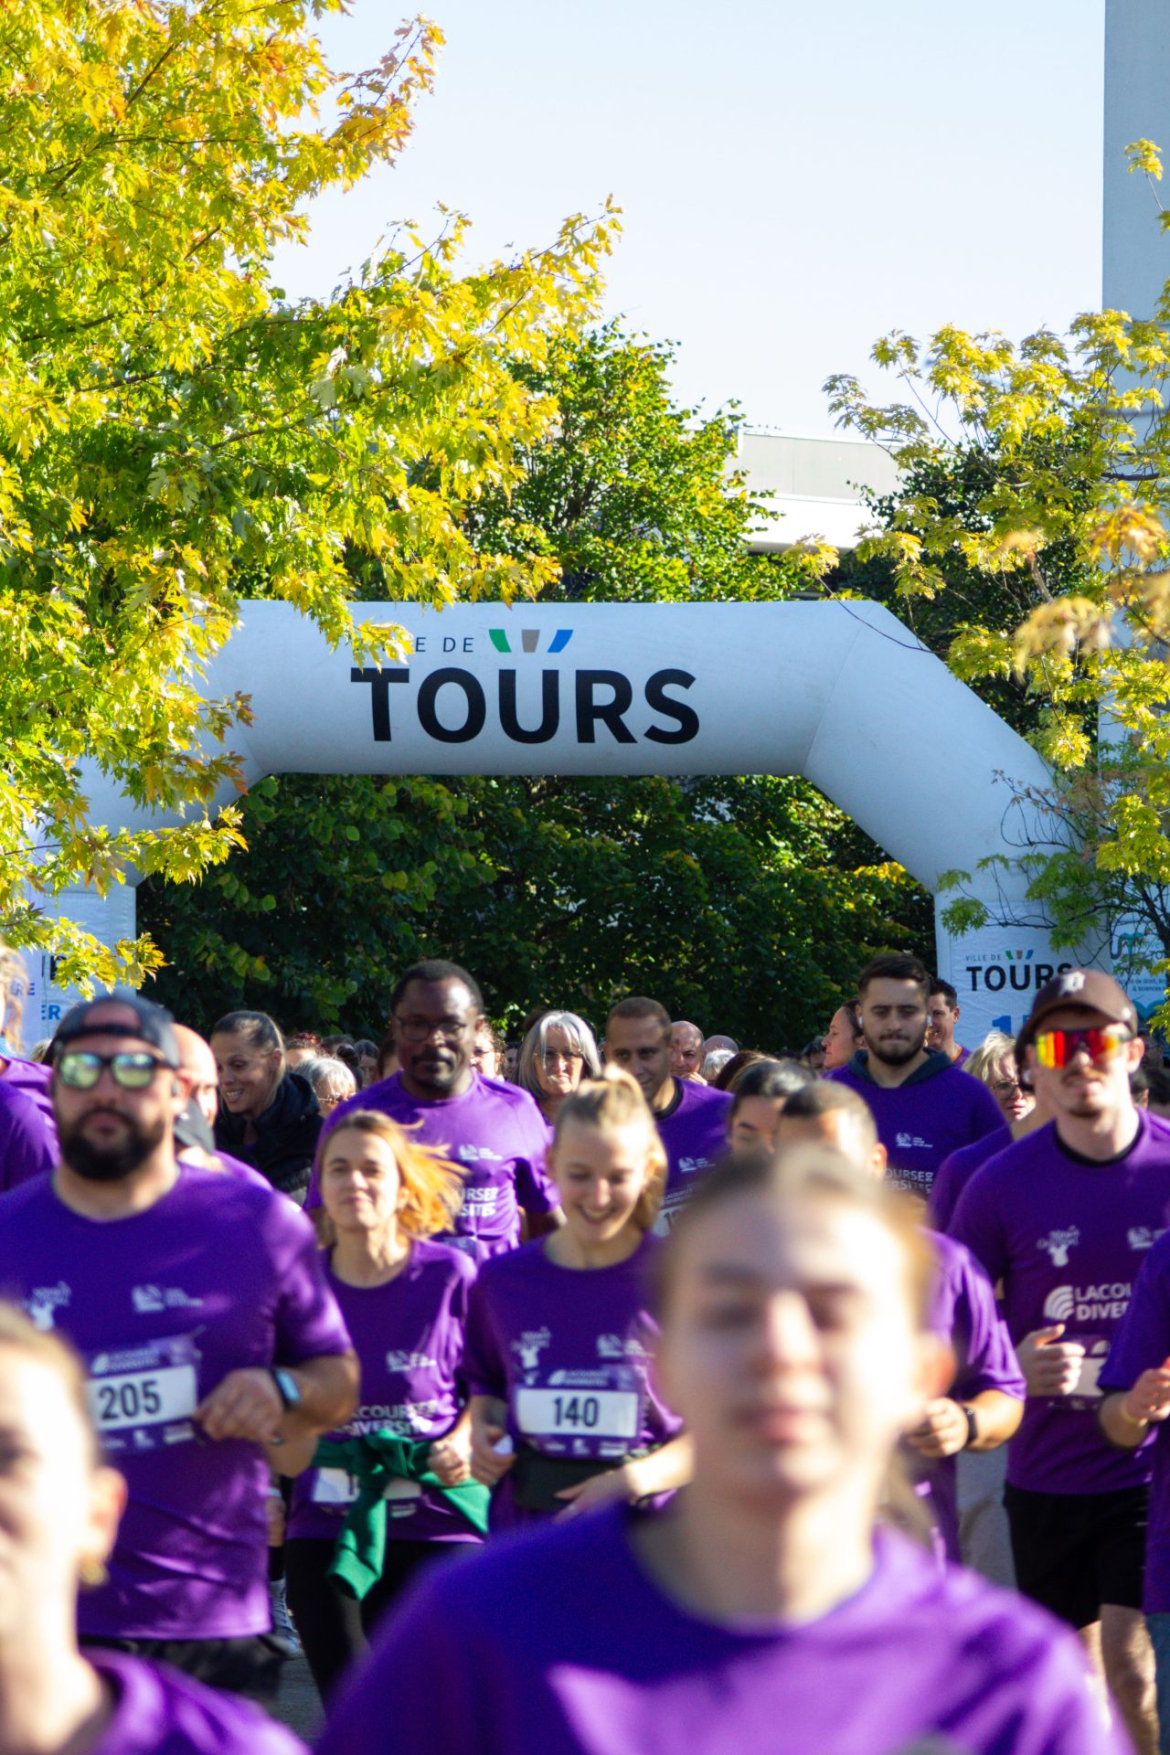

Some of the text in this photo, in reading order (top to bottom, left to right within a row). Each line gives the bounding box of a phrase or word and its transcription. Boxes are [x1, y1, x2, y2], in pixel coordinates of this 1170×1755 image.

[443, 637, 474, 653] DE
[350, 667, 700, 745] TOURS
[965, 953, 1001, 962] VILLE DE
[98, 1380, 161, 1420] 205
[553, 1396, 599, 1427] 140
